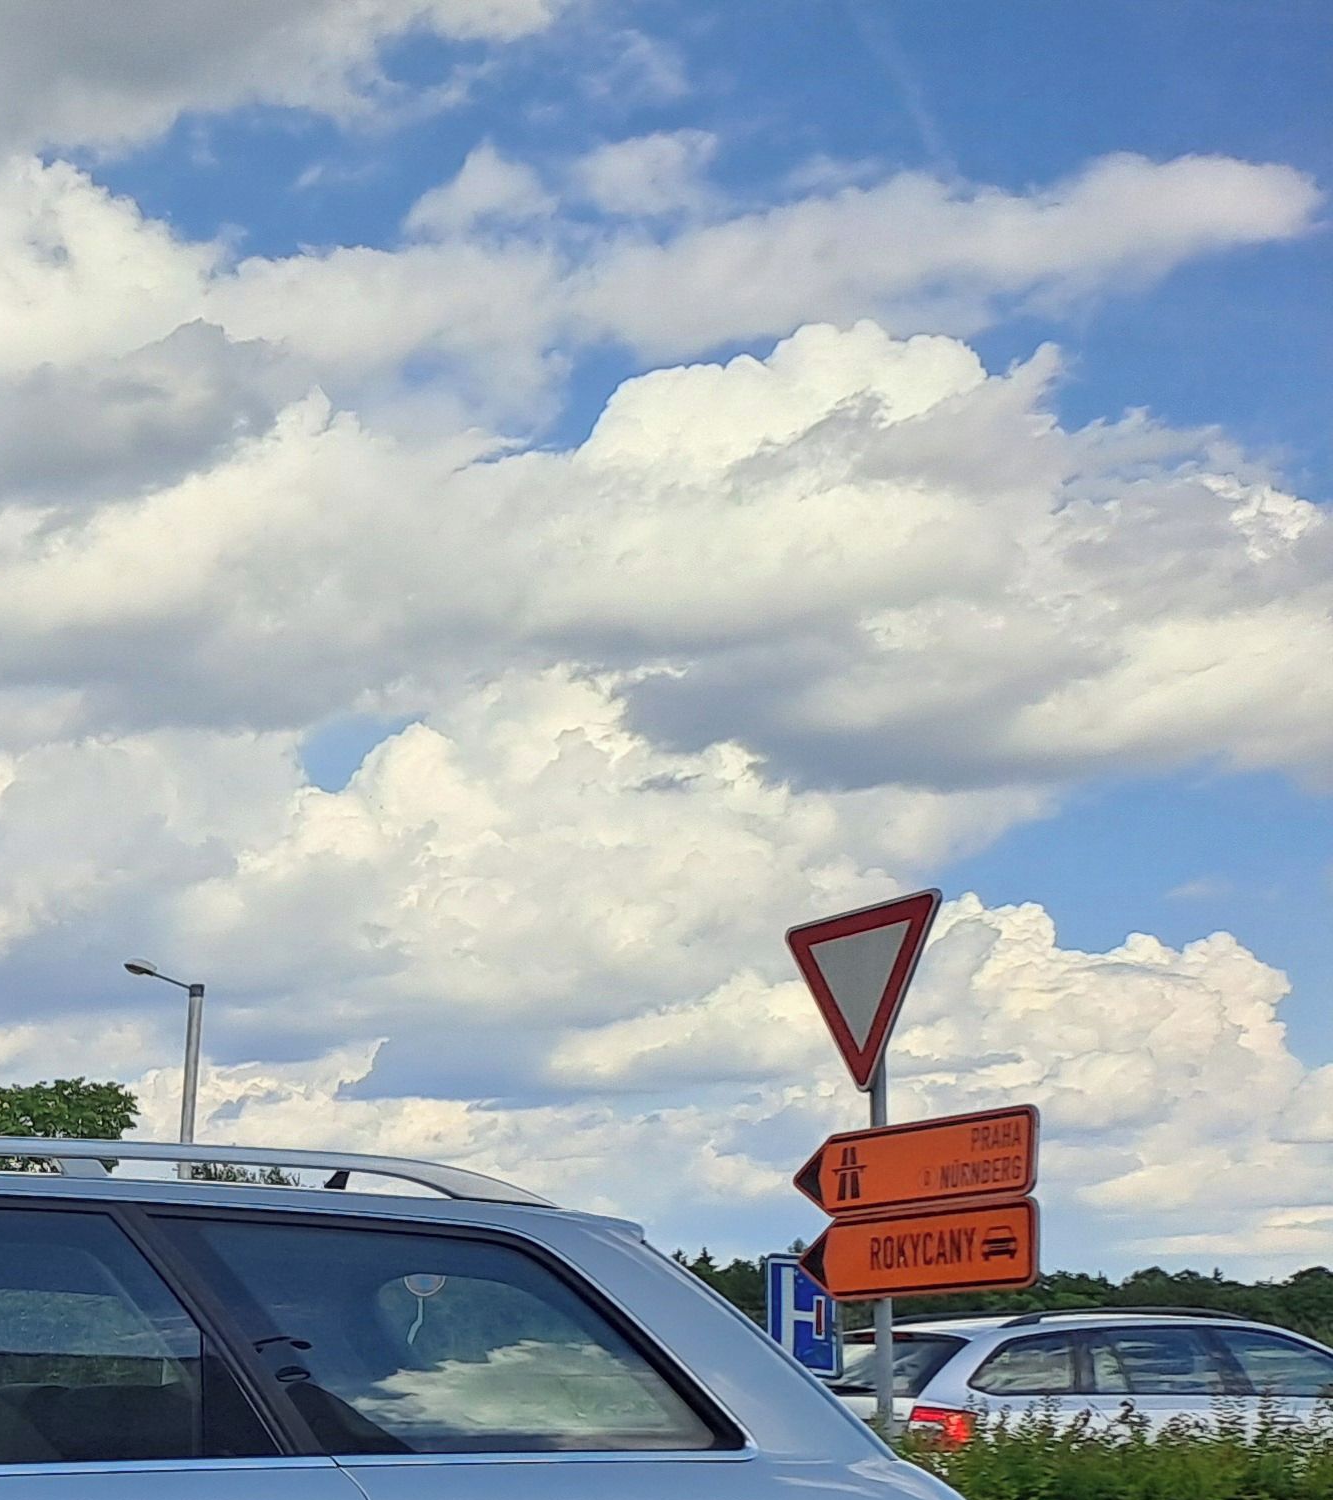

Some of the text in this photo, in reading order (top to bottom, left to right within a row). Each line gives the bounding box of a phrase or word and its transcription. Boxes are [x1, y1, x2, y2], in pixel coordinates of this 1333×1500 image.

[971, 1121, 1022, 1152] PRAHA
[939, 1155, 1023, 1189] NÜRNBERG
[870, 1227, 976, 1271] ROKYCANY
